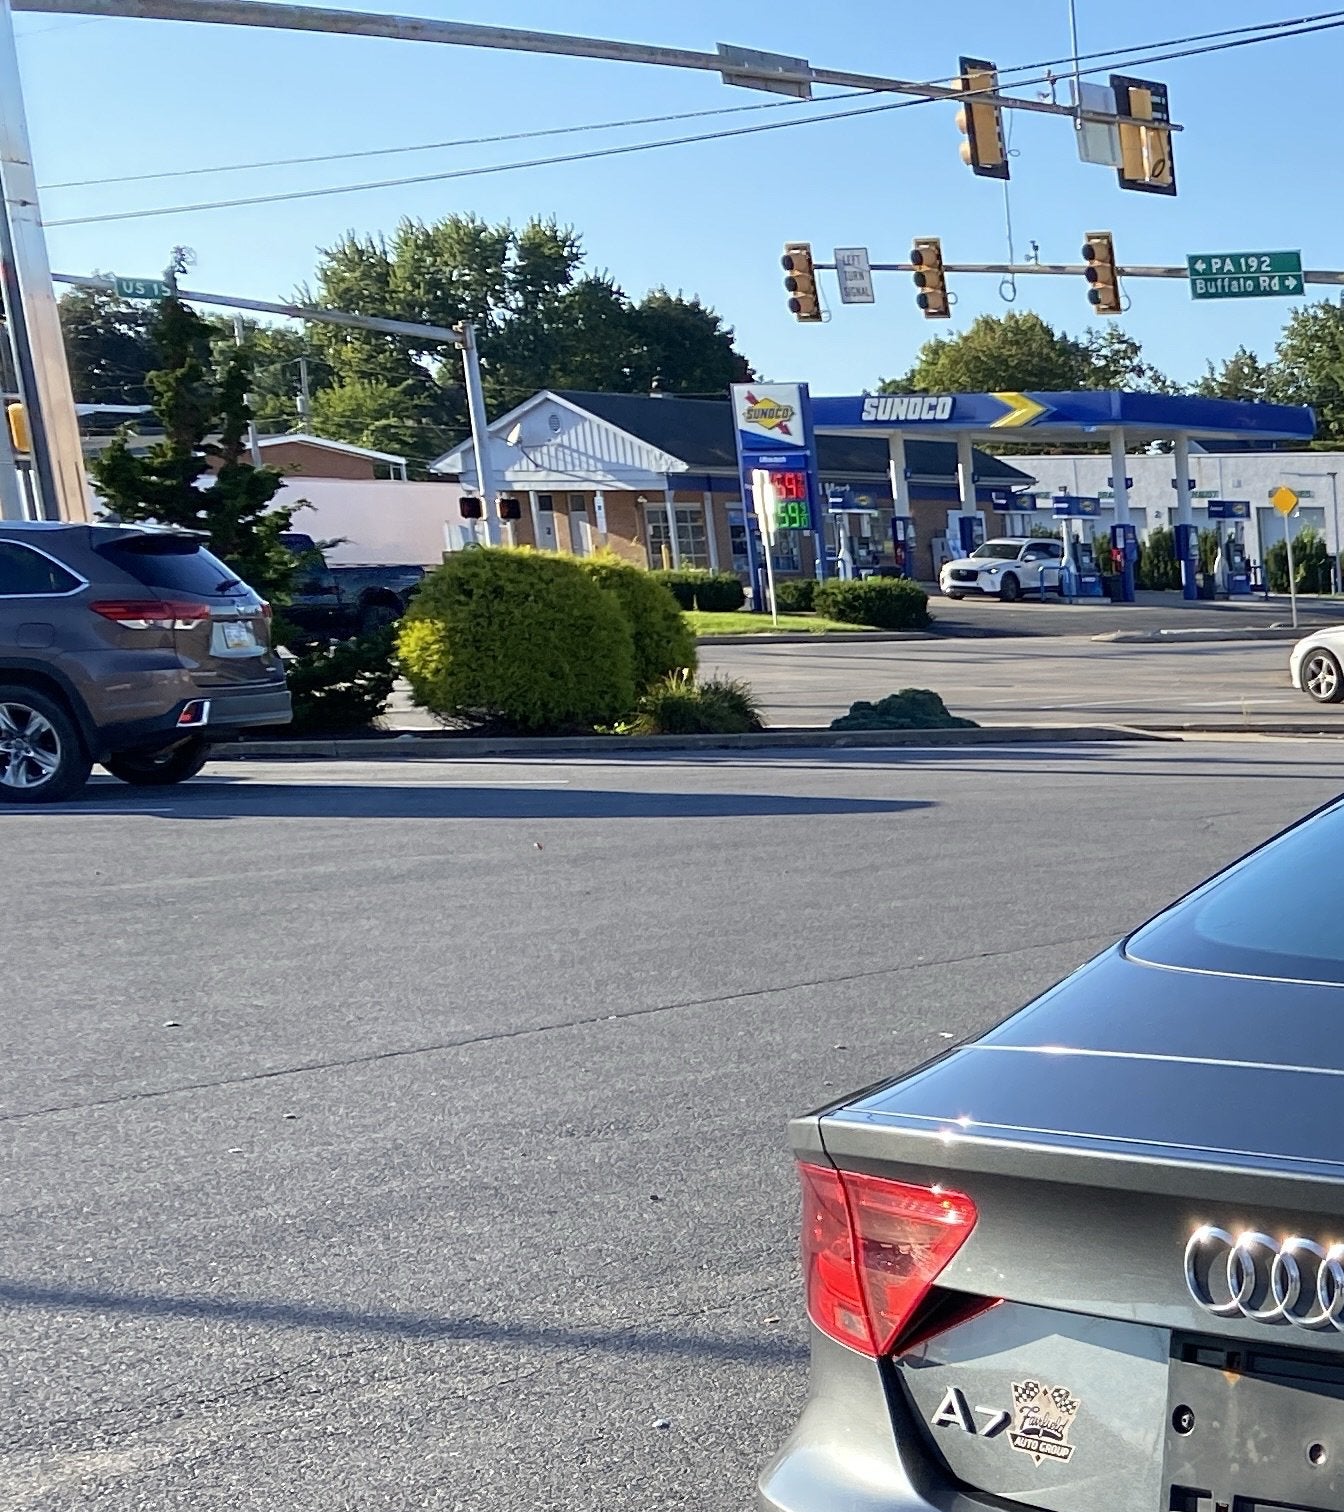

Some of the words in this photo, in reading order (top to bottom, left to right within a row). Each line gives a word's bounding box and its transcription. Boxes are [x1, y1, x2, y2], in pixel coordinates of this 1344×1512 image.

[843, 254, 860, 265] LEFT
[1210, 257, 1235, 273] PA
[1240, 255, 1272, 272] 192
[845, 270, 865, 281] TURN
[1195, 278, 1254, 294] Buffalo
[1259, 275, 1280, 291] Rd
[122, 281, 145, 294] US
[844, 286, 872, 297] SIGNAL
[745, 407, 790, 420] SUNOCO
[862, 396, 953, 421] SUNOCO
[931, 1385, 1012, 1438] A7
[1019, 1405, 1070, 1436] Fairfield
[1013, 1435, 1039, 1452] AUTO
[1038, 1442, 1071, 1458] GROUP
